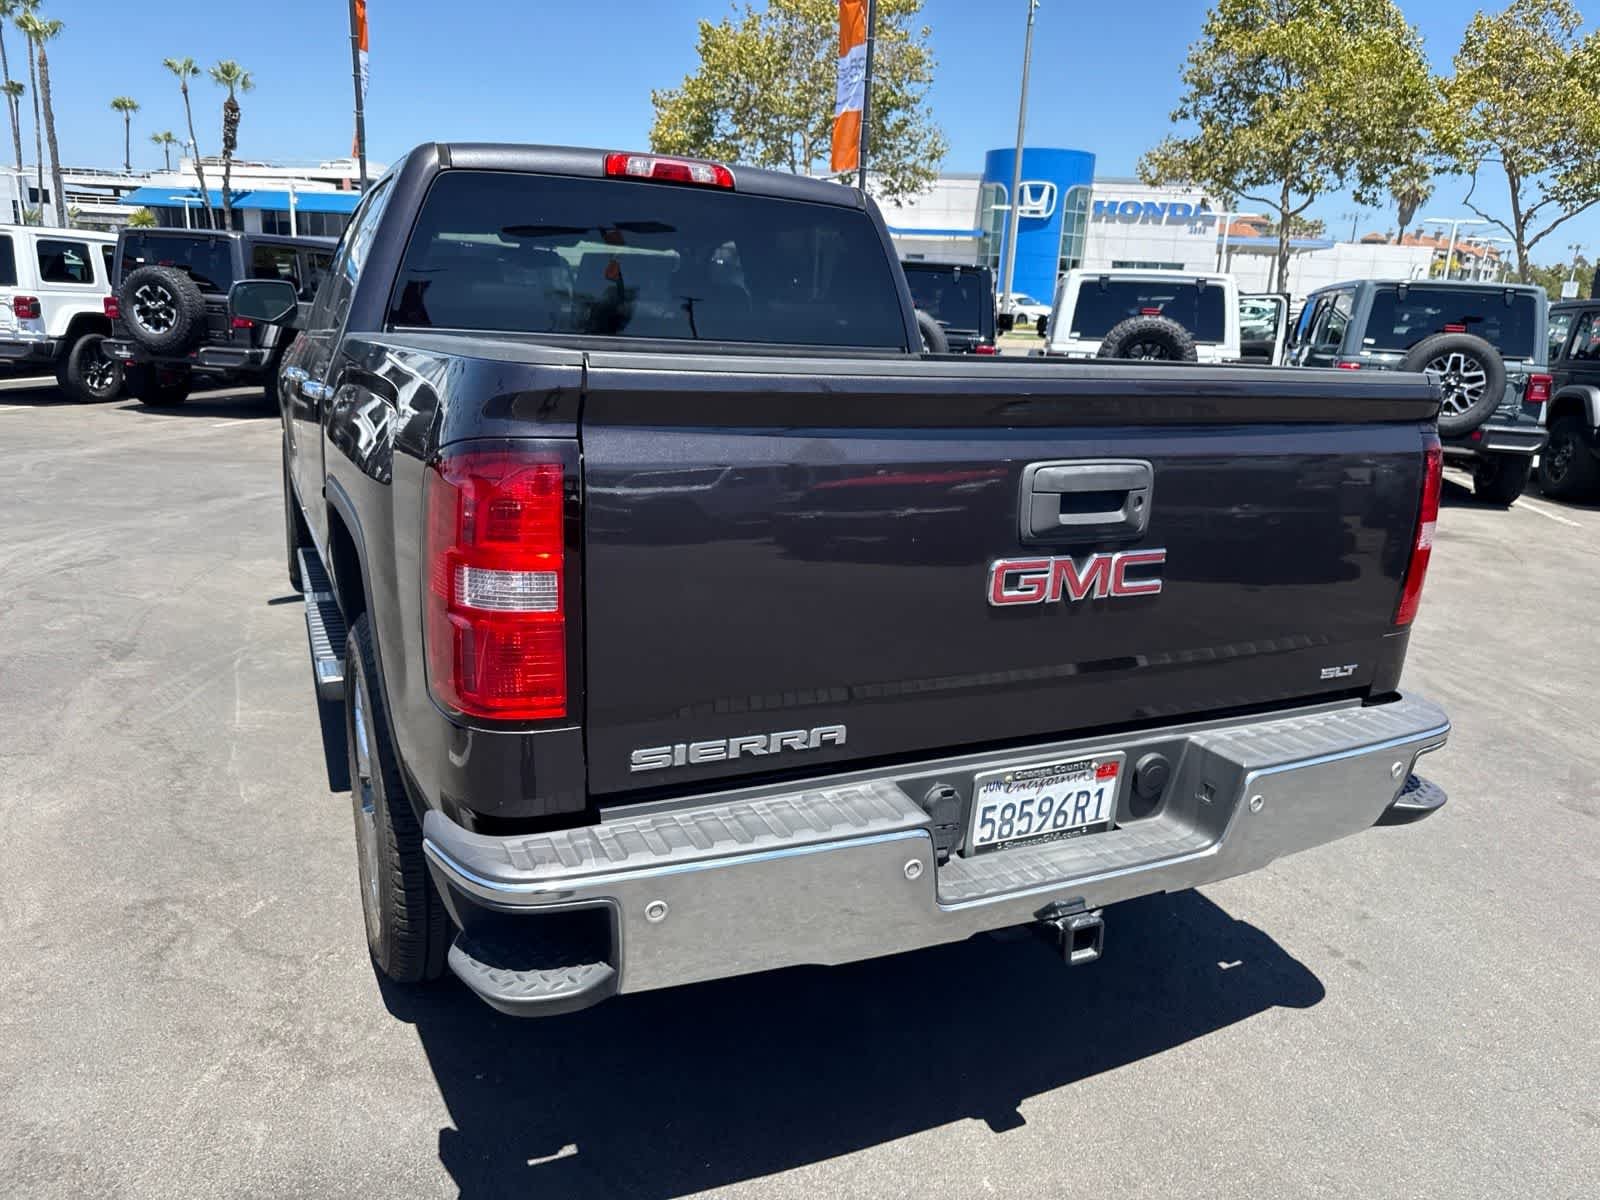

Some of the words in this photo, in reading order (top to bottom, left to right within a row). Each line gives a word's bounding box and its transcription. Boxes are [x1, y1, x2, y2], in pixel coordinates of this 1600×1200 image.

[988, 548, 1167, 606] GMC
[1320, 664, 1358, 679] SLT
[630, 724, 847, 773] SIERRA
[1054, 761, 1090, 775] County
[983, 780, 1002, 793] JUN
[979, 787, 1106, 843] 58596R1
